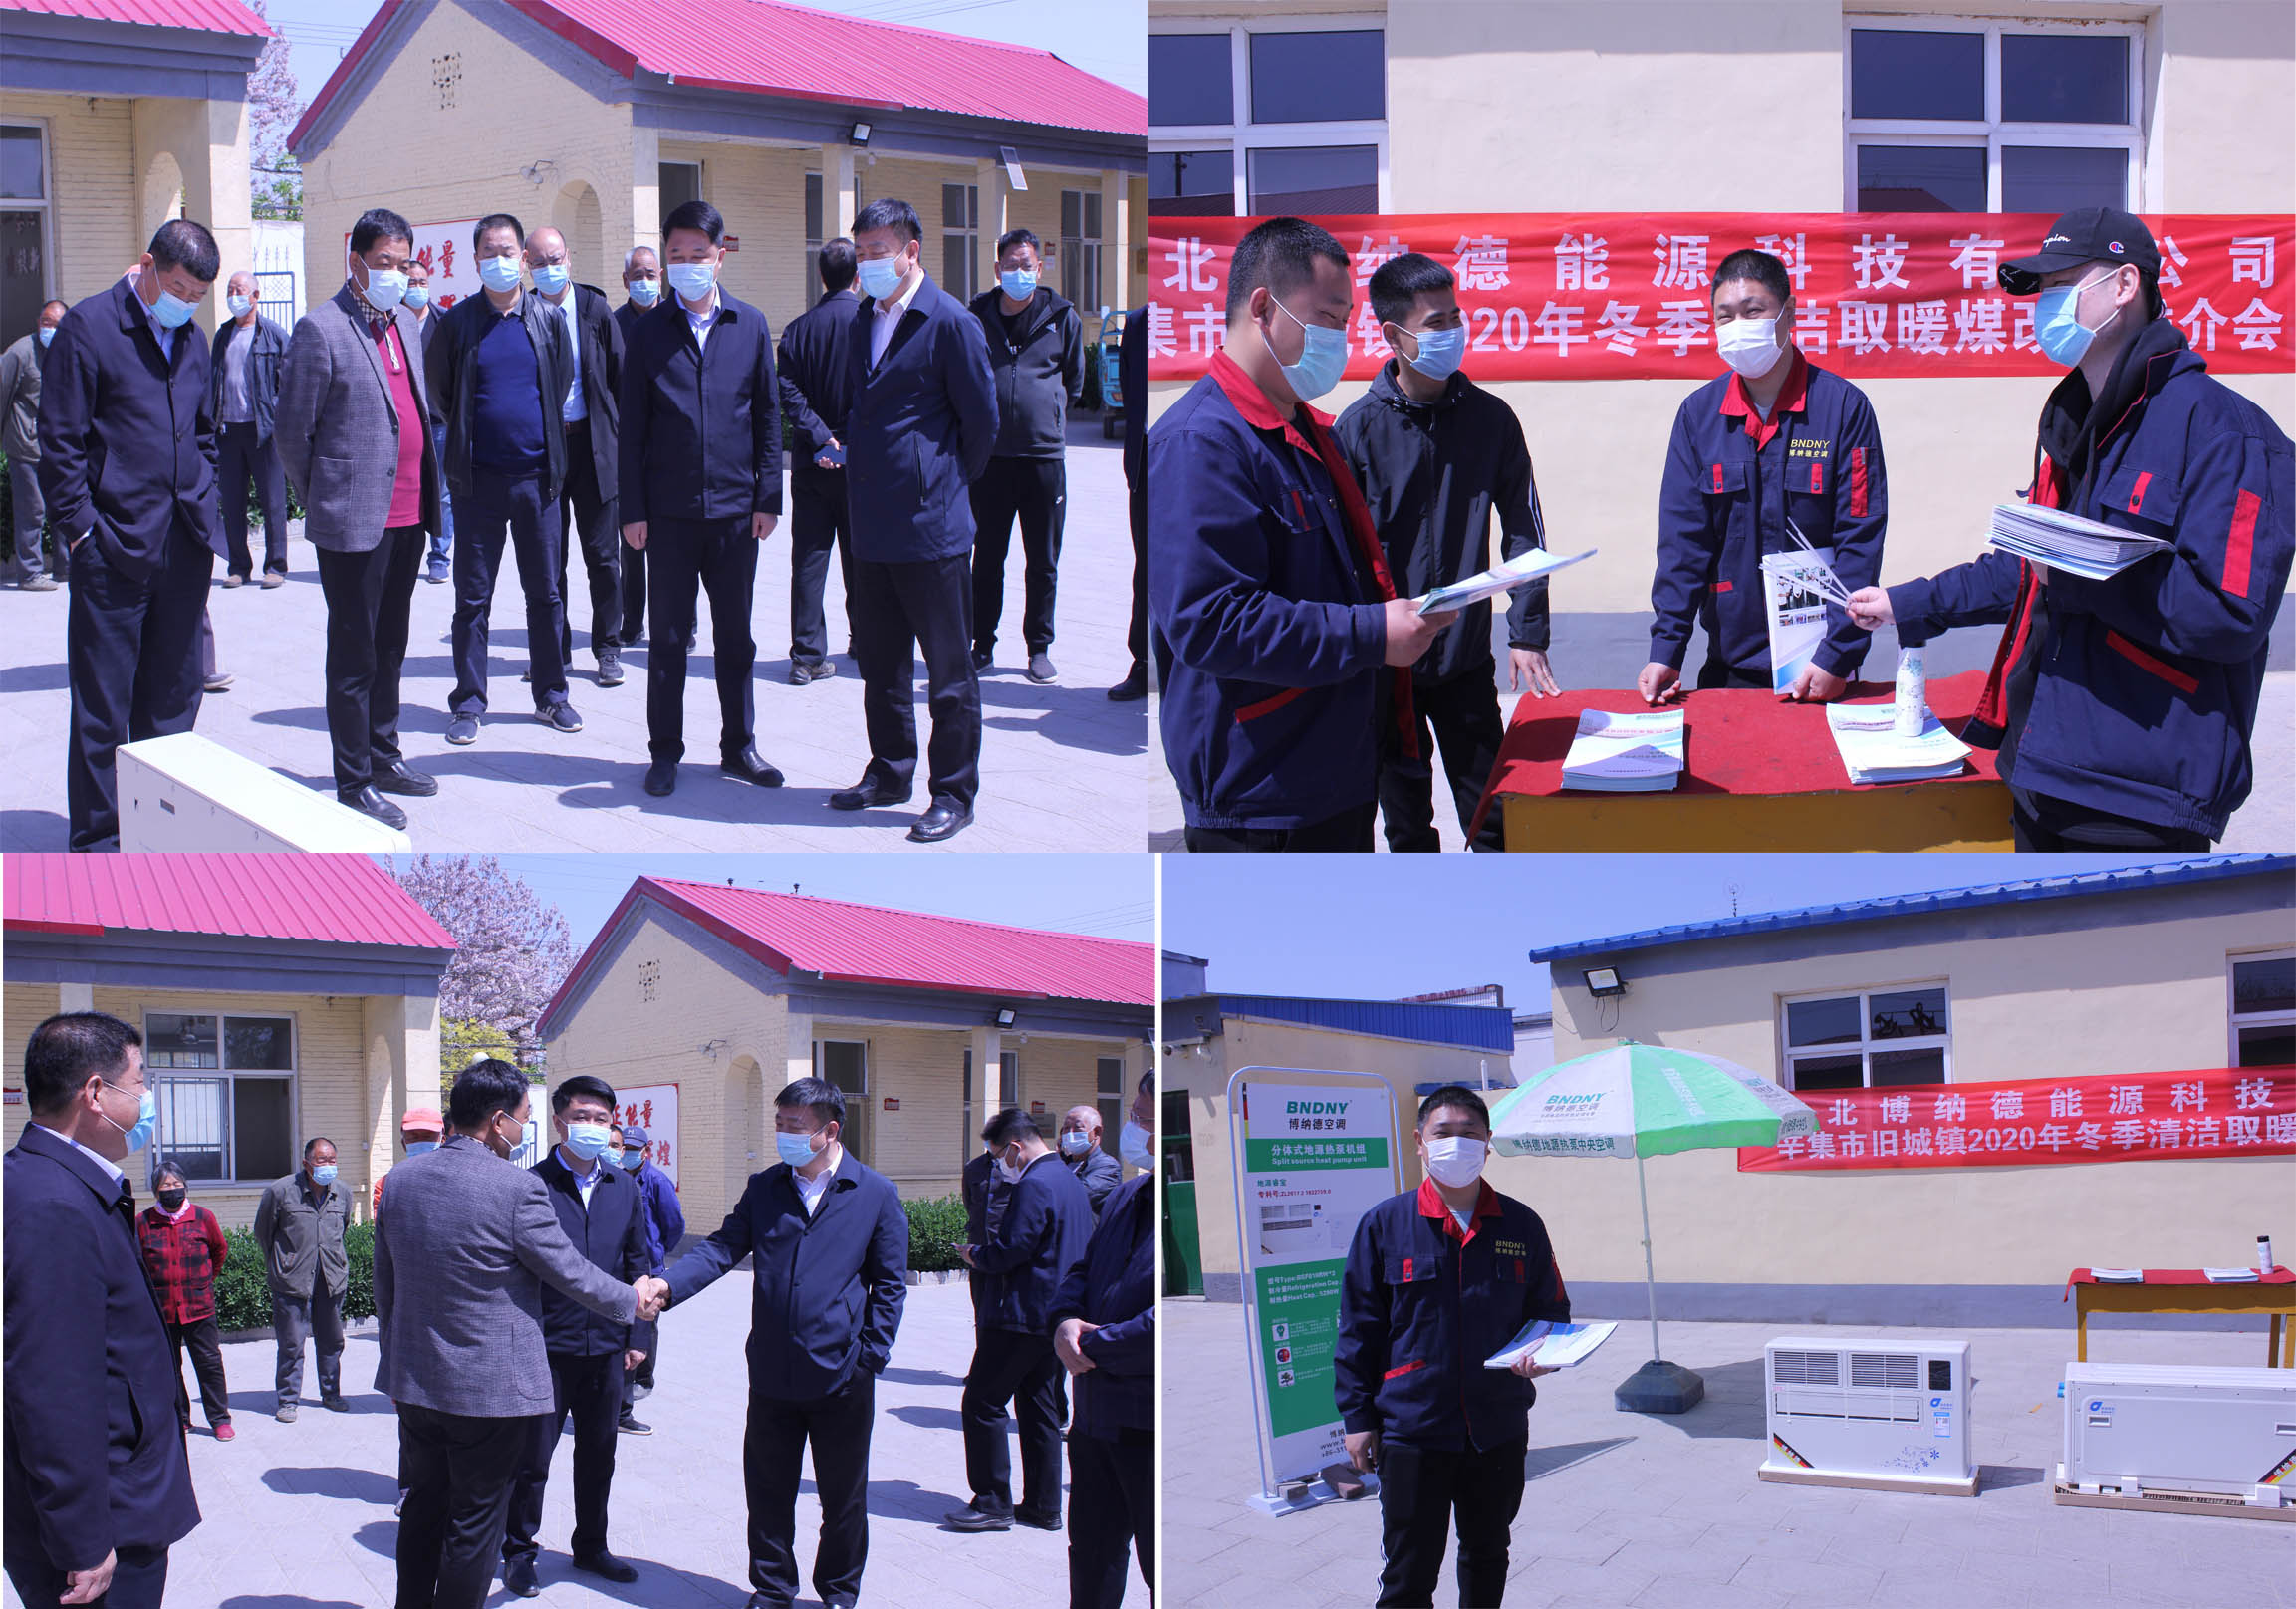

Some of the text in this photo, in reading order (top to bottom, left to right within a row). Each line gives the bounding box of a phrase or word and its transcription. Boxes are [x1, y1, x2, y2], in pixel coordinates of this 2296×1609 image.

[1790, 438, 1831, 449] BNDNY
[1547, 1091, 1607, 1105] BNDNY
[1286, 1100, 1349, 1115] BNDNY
[1288, 1117, 1347, 1131] 博纳德空调
